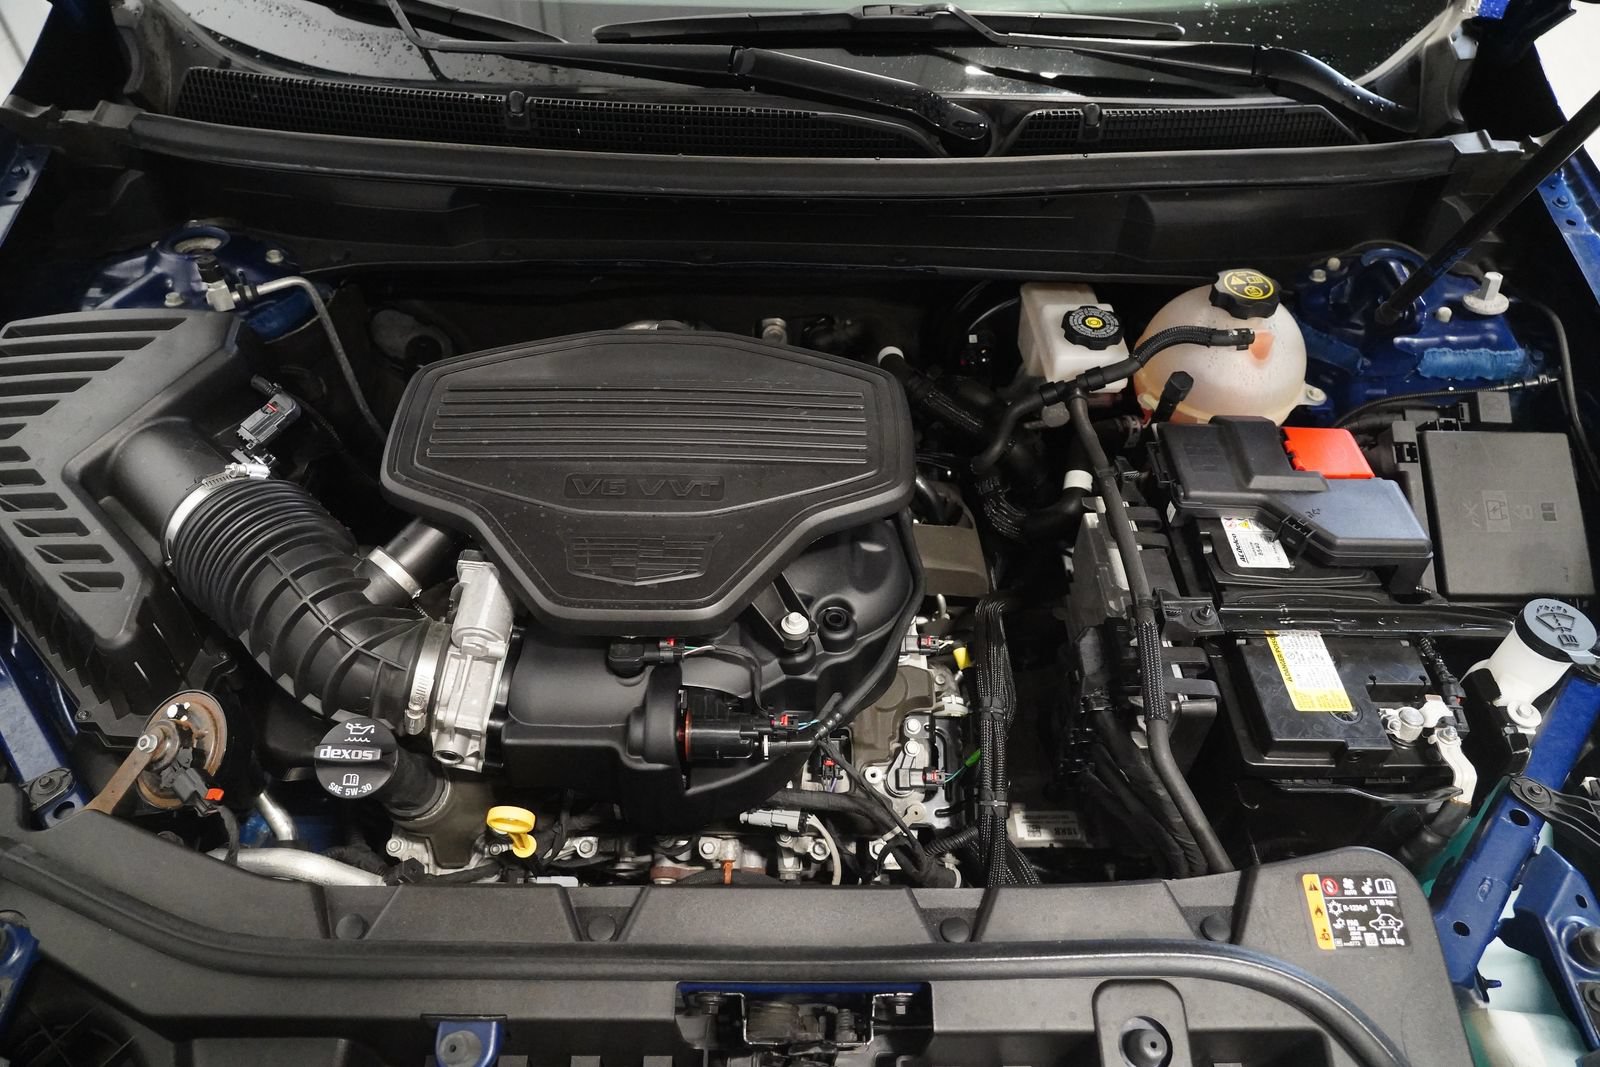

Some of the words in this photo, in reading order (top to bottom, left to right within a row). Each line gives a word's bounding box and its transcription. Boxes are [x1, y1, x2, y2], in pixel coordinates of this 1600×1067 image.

[572, 478, 626, 496] V6
[638, 479, 720, 497] VVT
[319, 745, 373, 760] dexos
[328, 781, 343, 795] SAE
[345, 783, 372, 796] 5W-30
